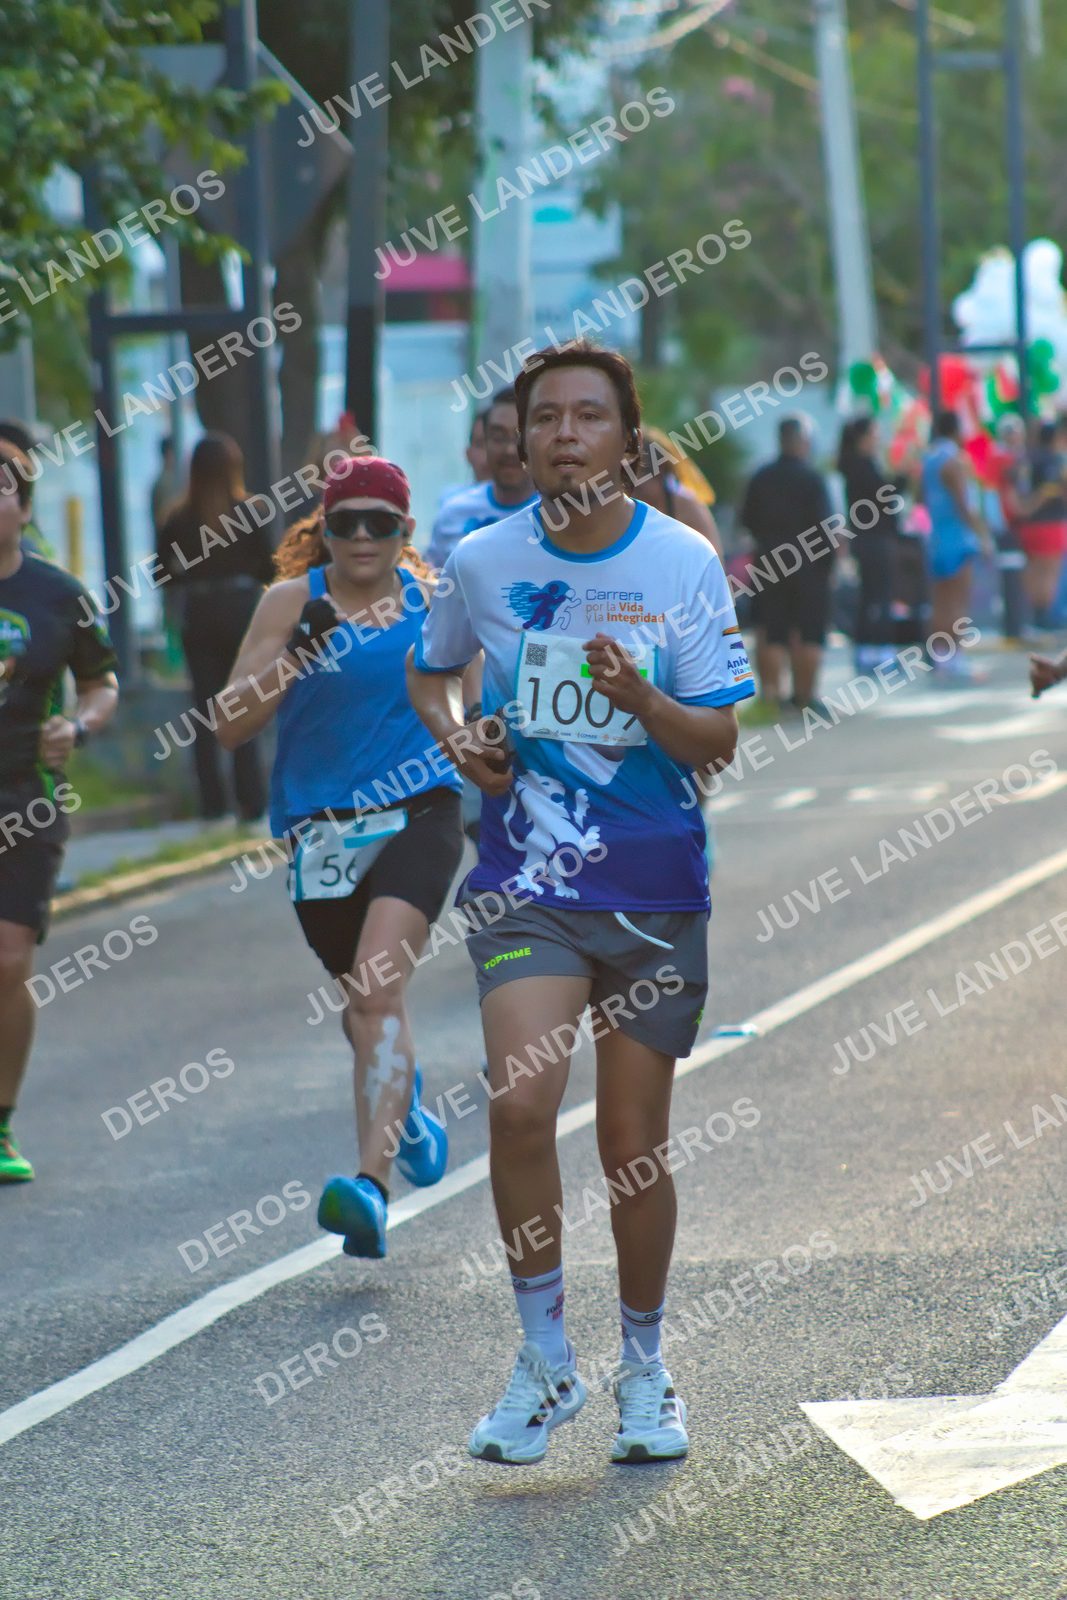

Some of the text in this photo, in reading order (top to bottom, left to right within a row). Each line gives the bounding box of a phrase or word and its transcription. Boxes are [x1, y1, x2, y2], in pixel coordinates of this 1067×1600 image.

[585, 589, 643, 601] Carrera
[585, 602, 643, 613] por la Vida
[594, 612, 604, 621] la
[606, 612, 665, 625] Integridad
[528, 677, 638, 731] 100
[484, 947, 532, 970] TOPTIME
